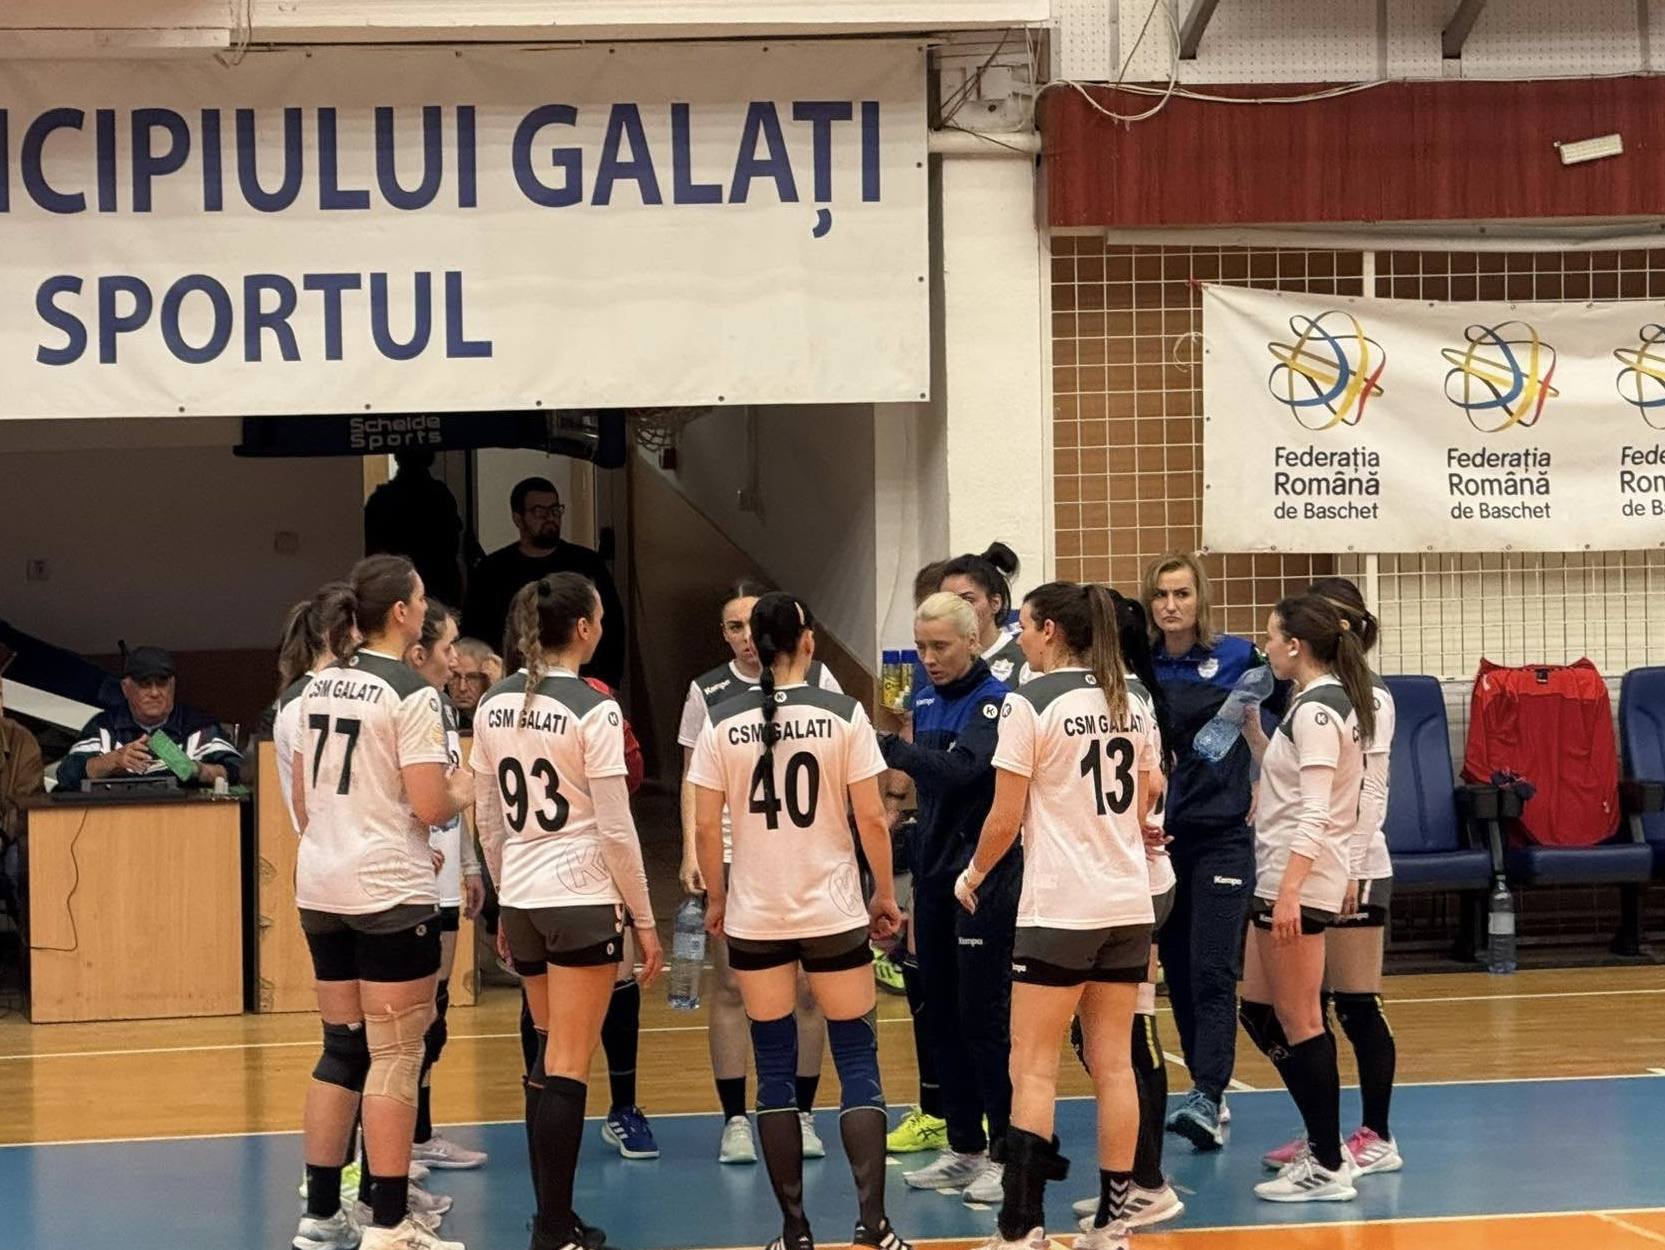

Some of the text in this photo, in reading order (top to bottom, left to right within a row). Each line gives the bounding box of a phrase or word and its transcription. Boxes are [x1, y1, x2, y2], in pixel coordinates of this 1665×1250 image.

[513, 101, 881, 238] GALAȚI
[36, 271, 493, 365] SPORTUL
[351, 430, 442, 450] Sports
[1275, 446, 1380, 473] Federația
[1447, 448, 1551, 474] Federația
[1274, 472, 1380, 496] Română
[1448, 472, 1550, 496] Română
[1274, 501, 1378, 519] de Baschet
[1451, 501, 1550, 519] de Baschet
[1622, 499, 1665, 517] de B
[333, 680, 384, 704] GALATI
[488, 708, 515, 729] CSM
[1064, 714, 1096, 737] CSM
[308, 713, 362, 796] 77
[1080, 736, 1136, 816] 13
[498, 756, 570, 833] 93
[749, 751, 820, 831] 40
